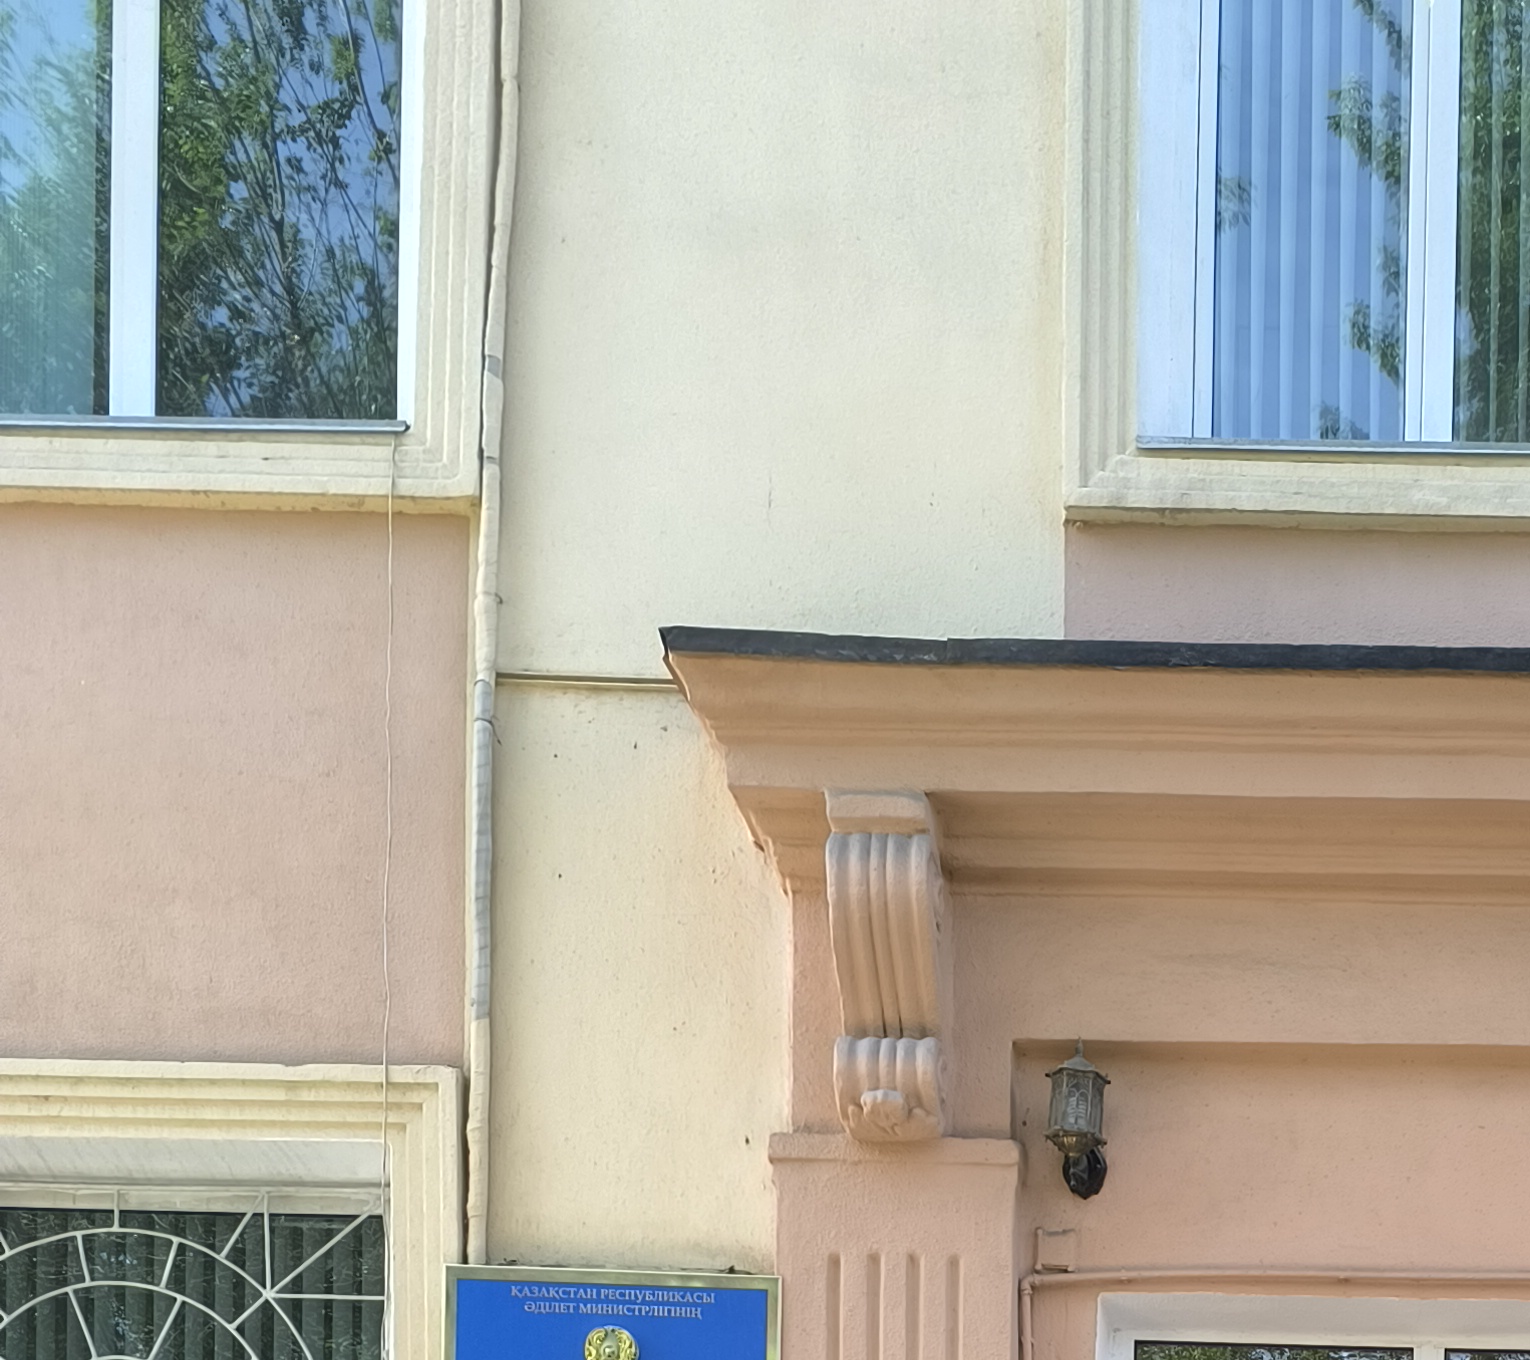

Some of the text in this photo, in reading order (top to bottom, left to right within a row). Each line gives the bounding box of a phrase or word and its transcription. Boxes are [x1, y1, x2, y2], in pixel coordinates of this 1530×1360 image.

[511, 1285, 715, 1304] ҚАЗАҚСТАН РЕСПУБЛИКАСЫ
[524, 1301, 702, 1319] ӘДІЛЕТ МИНИСТРЛІГІНІҢ
